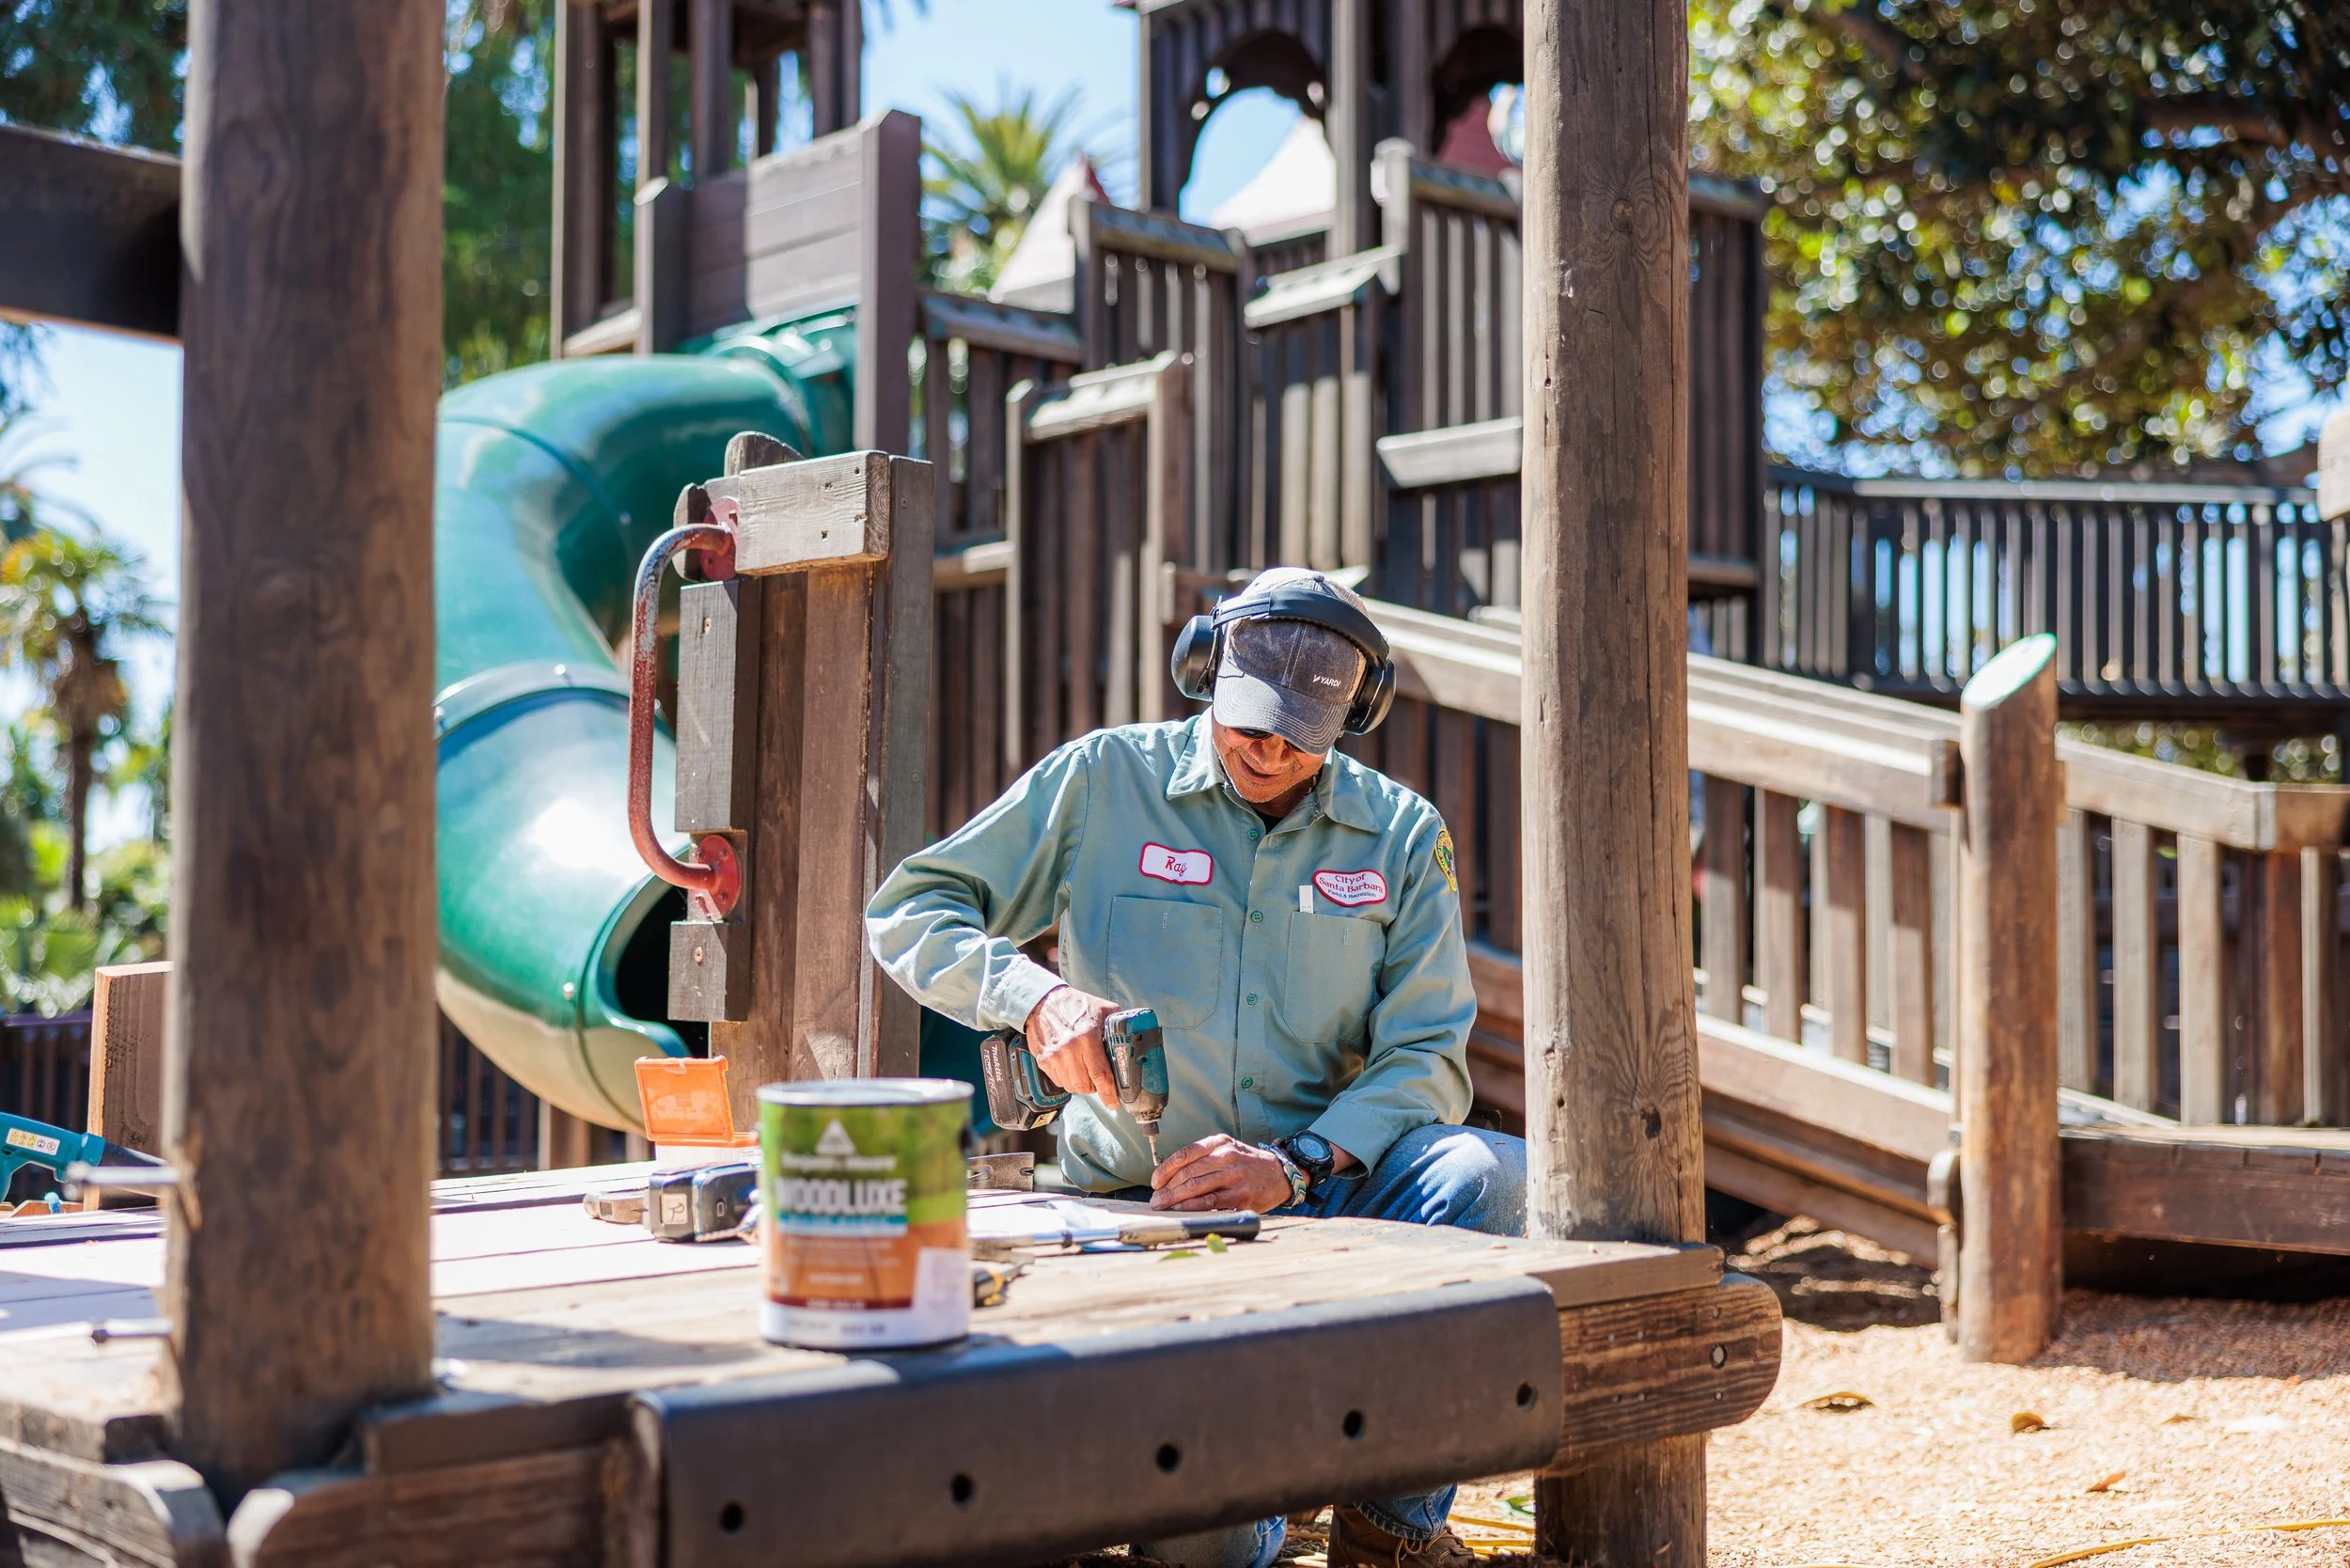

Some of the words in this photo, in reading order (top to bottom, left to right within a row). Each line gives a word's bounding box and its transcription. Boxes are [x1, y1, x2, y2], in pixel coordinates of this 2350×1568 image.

[1321, 676, 1341, 687] YARDI
[1165, 855, 1187, 876] Ray
[1319, 877, 1344, 892] Santa
[1347, 883, 1383, 893] Barbara
[1335, 875, 1355, 885] City
[1355, 873, 1366, 882] of
